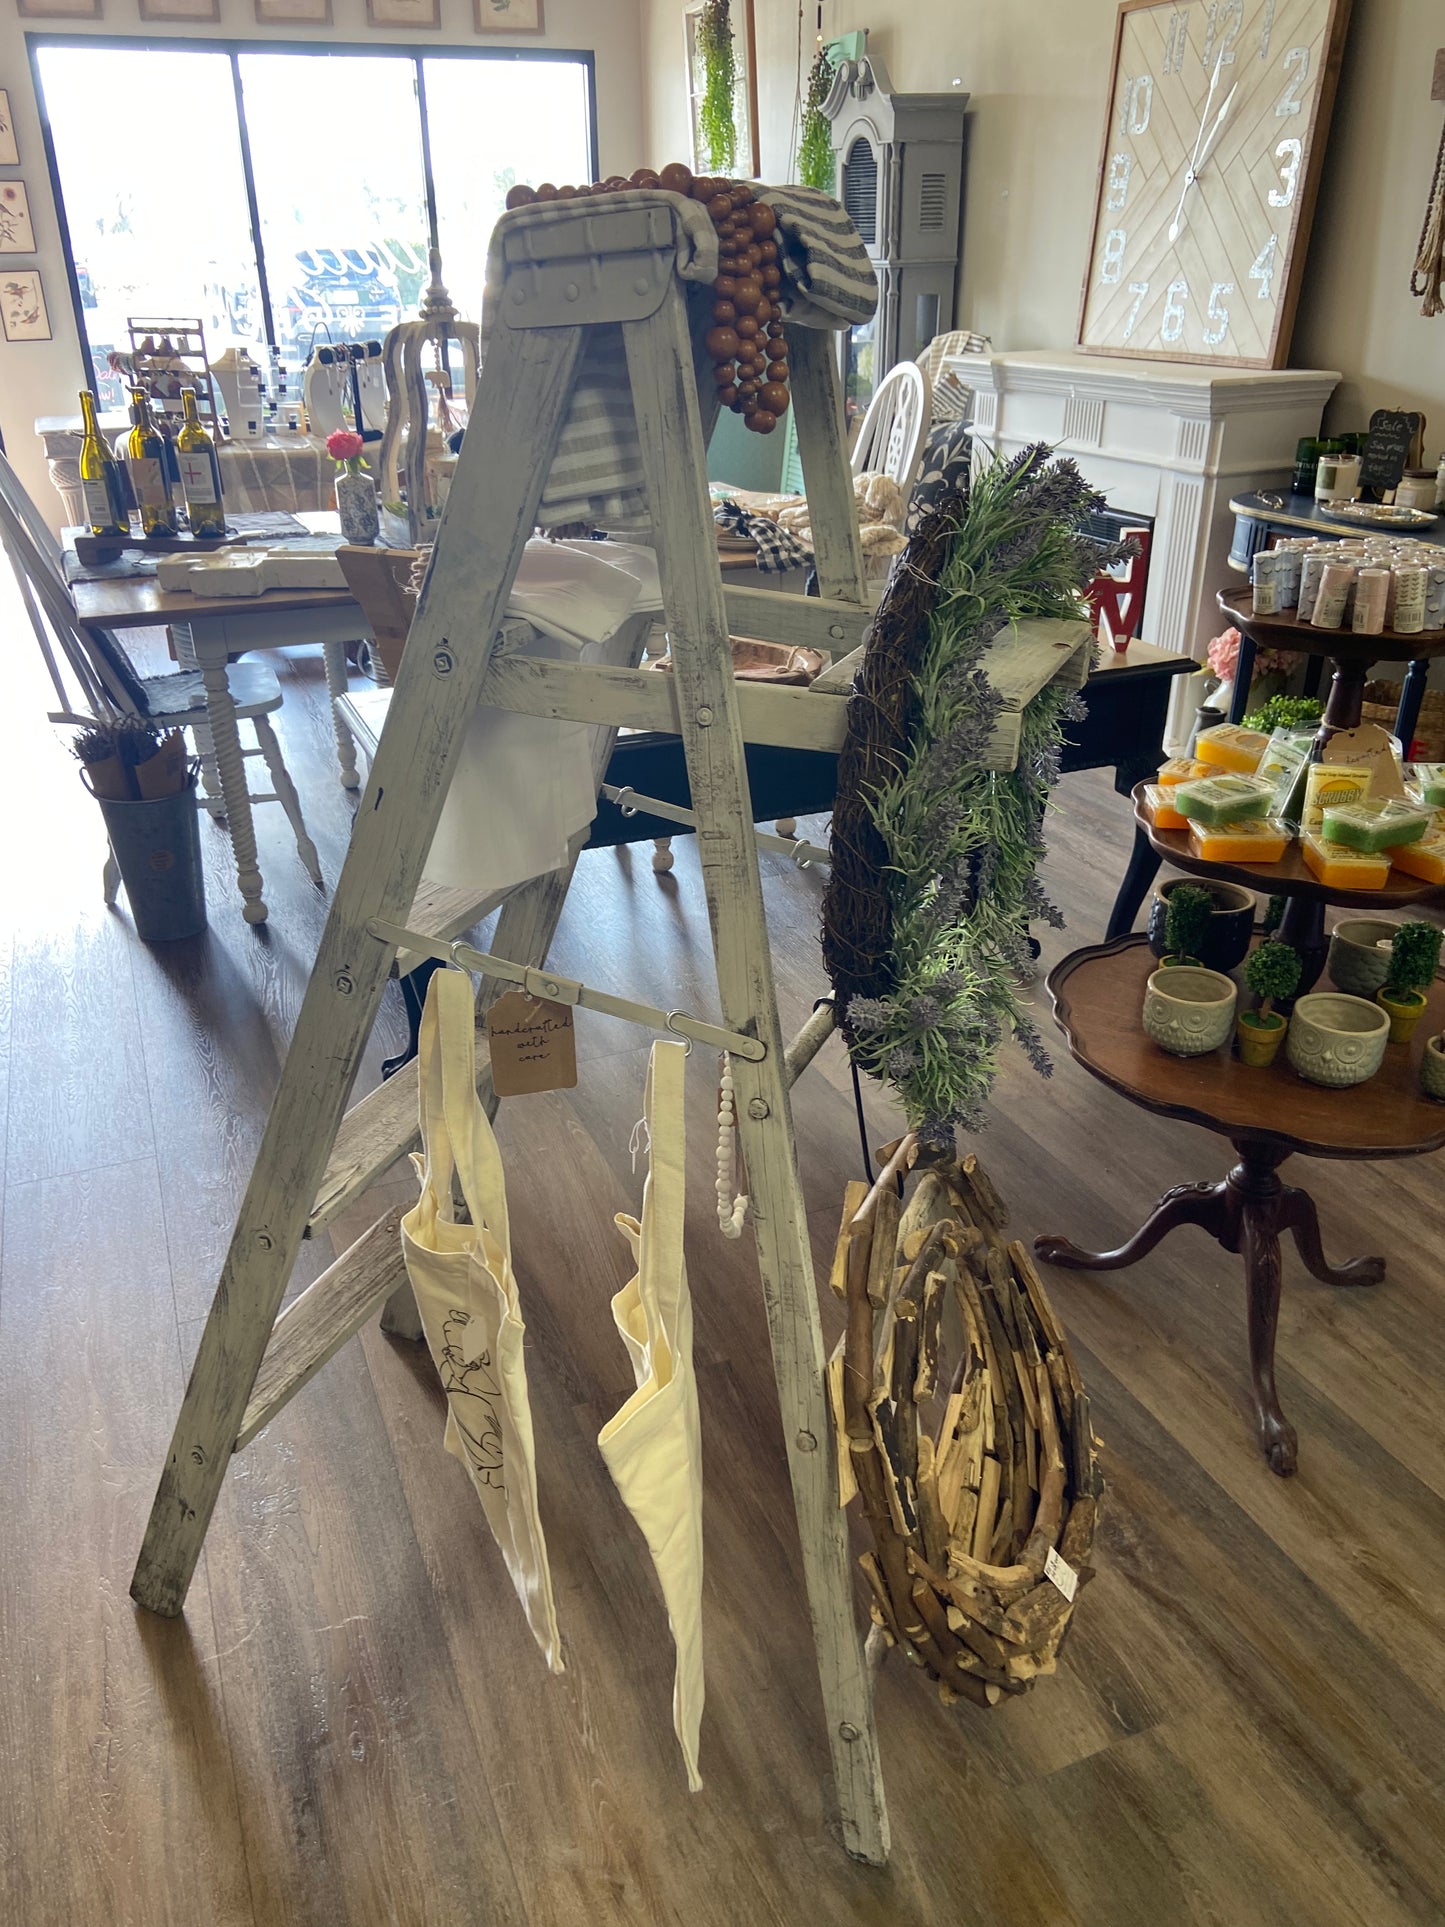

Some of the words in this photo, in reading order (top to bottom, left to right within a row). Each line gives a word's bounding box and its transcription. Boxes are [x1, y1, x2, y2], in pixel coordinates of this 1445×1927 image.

[1162, 10, 1189, 74] 11
[1201, 0, 1243, 68] 12
[1119, 74, 1154, 136] 10
[1275, 46, 1310, 118] 2
[1106, 152, 1132, 212] 9
[1267, 138, 1302, 208] 3
[1101, 229, 1127, 284] 8
[1248, 233, 1278, 299] 4
[1125, 281, 1150, 338] 7
[1161, 280, 1188, 342] 6
[1203, 282, 1235, 345] 5
[1311, 788, 1365, 807] SCRUBBY
